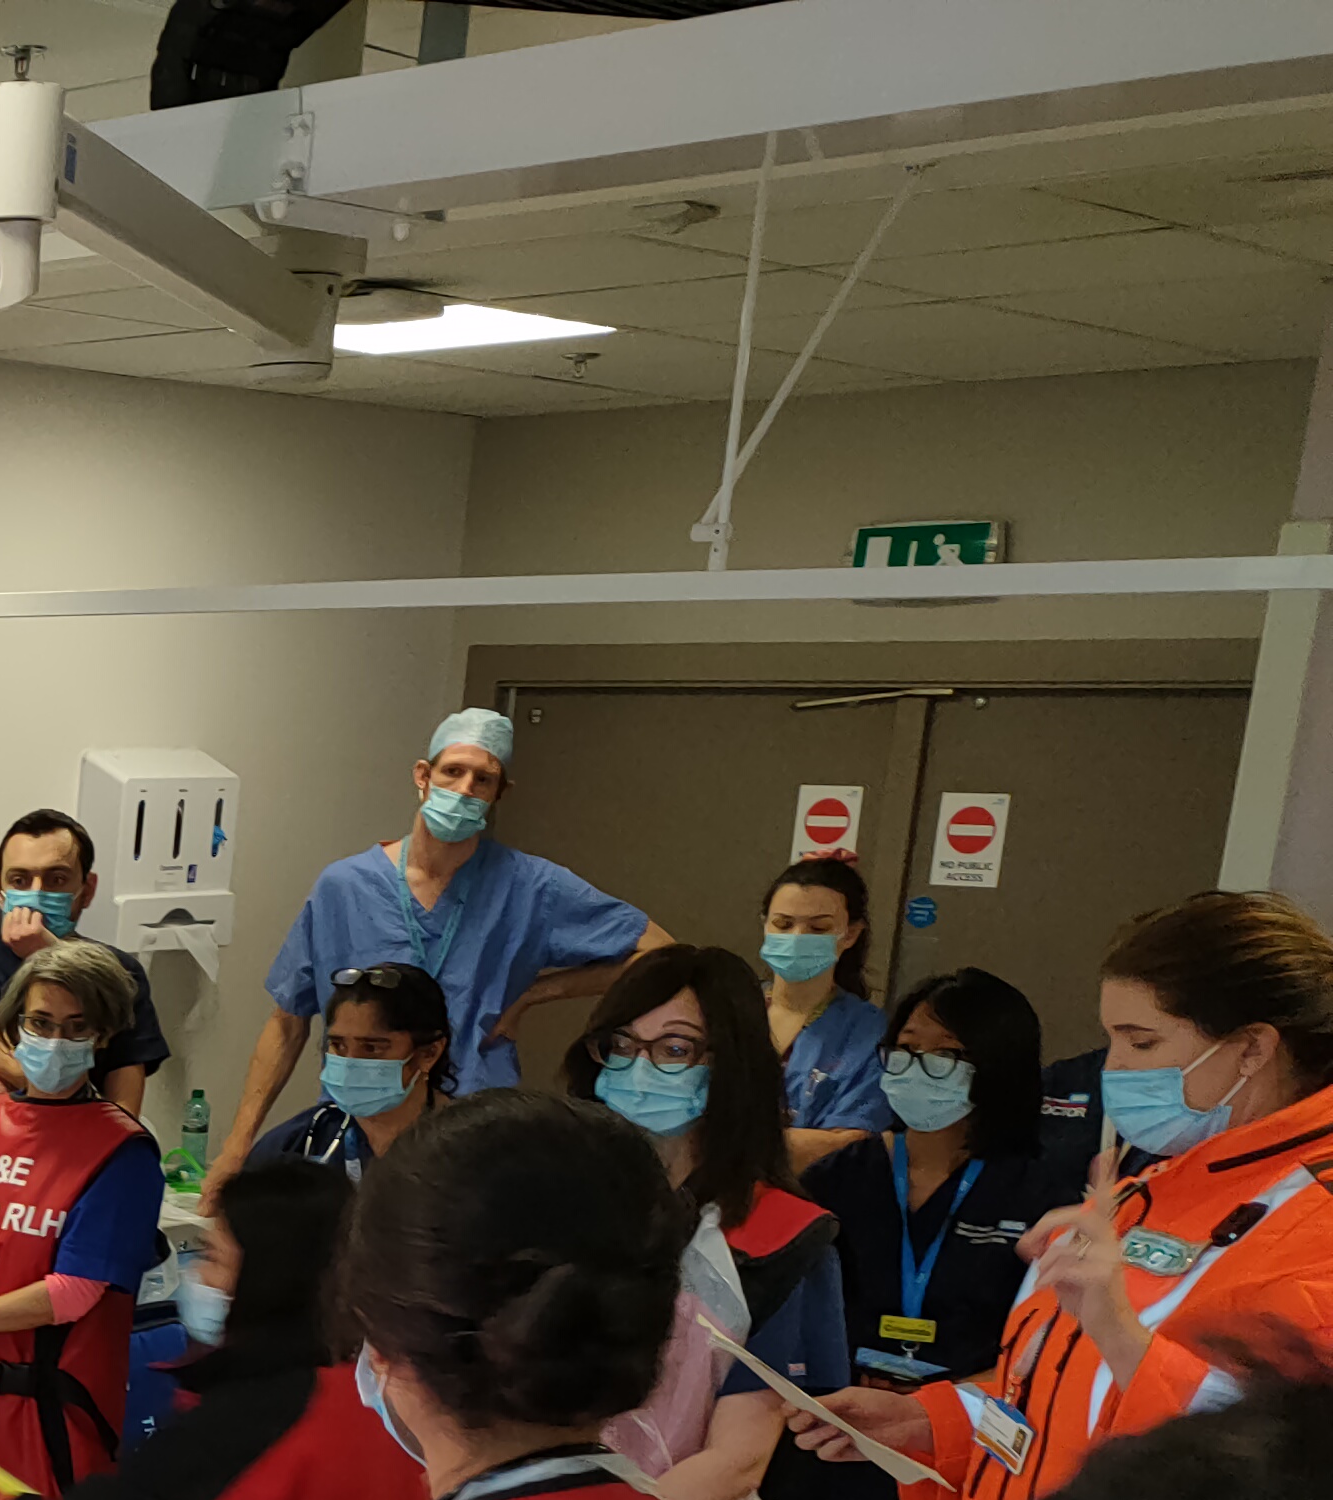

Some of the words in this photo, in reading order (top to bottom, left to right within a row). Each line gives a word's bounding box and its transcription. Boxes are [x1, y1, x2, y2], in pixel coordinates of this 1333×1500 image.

[939, 861, 955, 870] NO
[956, 861, 994, 871] PUBLIC
[1040, 1104, 1086, 1118] OCTOR
[1, 1202, 68, 1239] RLH
